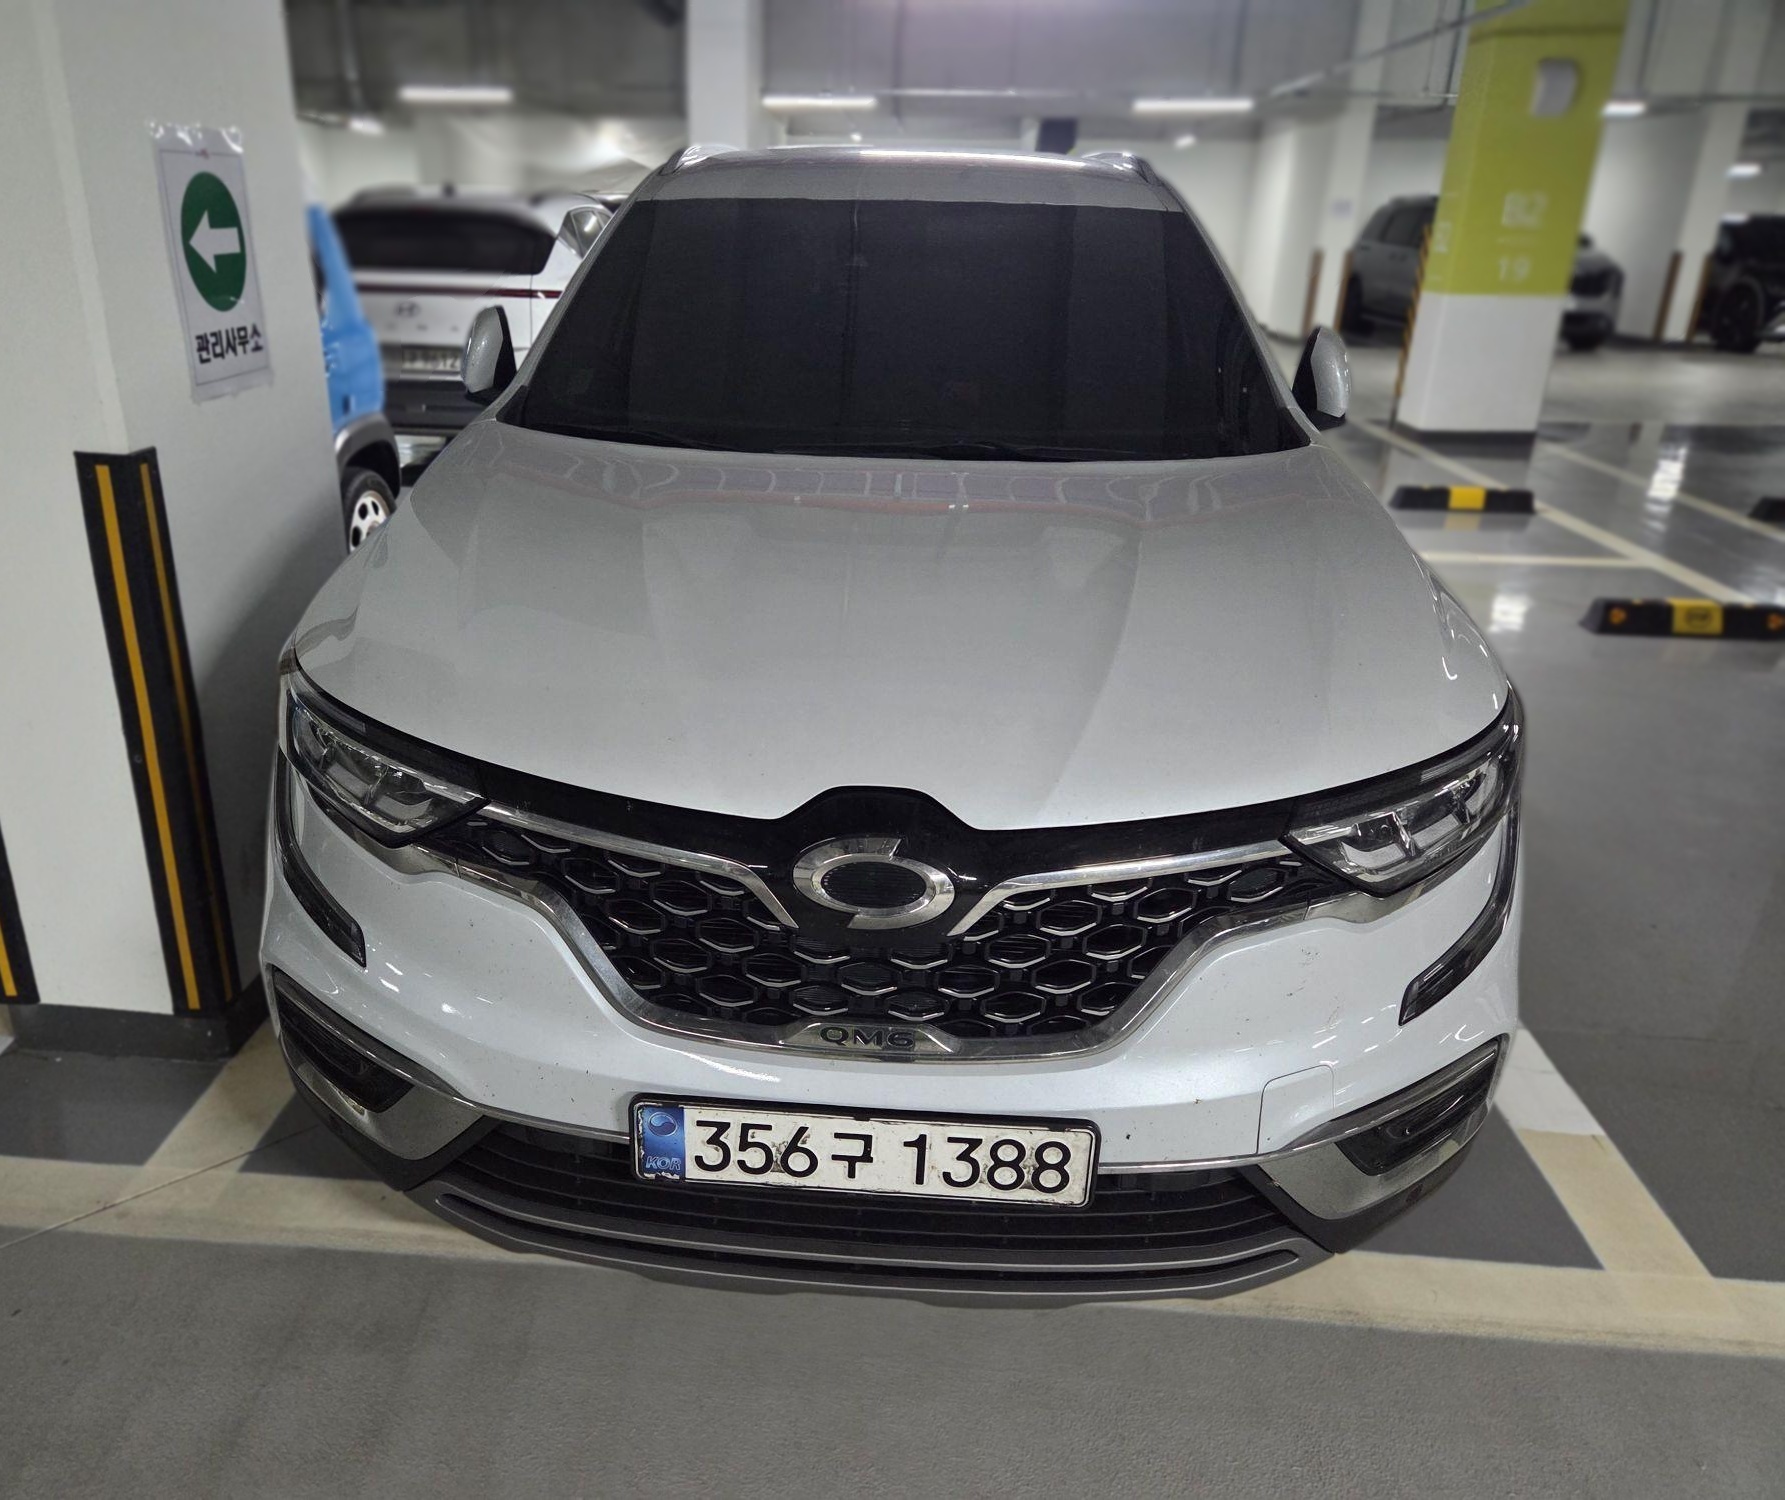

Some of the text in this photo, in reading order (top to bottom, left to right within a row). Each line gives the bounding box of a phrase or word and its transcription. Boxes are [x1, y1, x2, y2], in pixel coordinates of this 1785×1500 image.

[195, 323, 263, 364] 관리사무소
[819, 1026, 915, 1047] QM6
[645, 1155, 682, 1171] KOR
[694, 1120, 1072, 1194] 356구 1388
